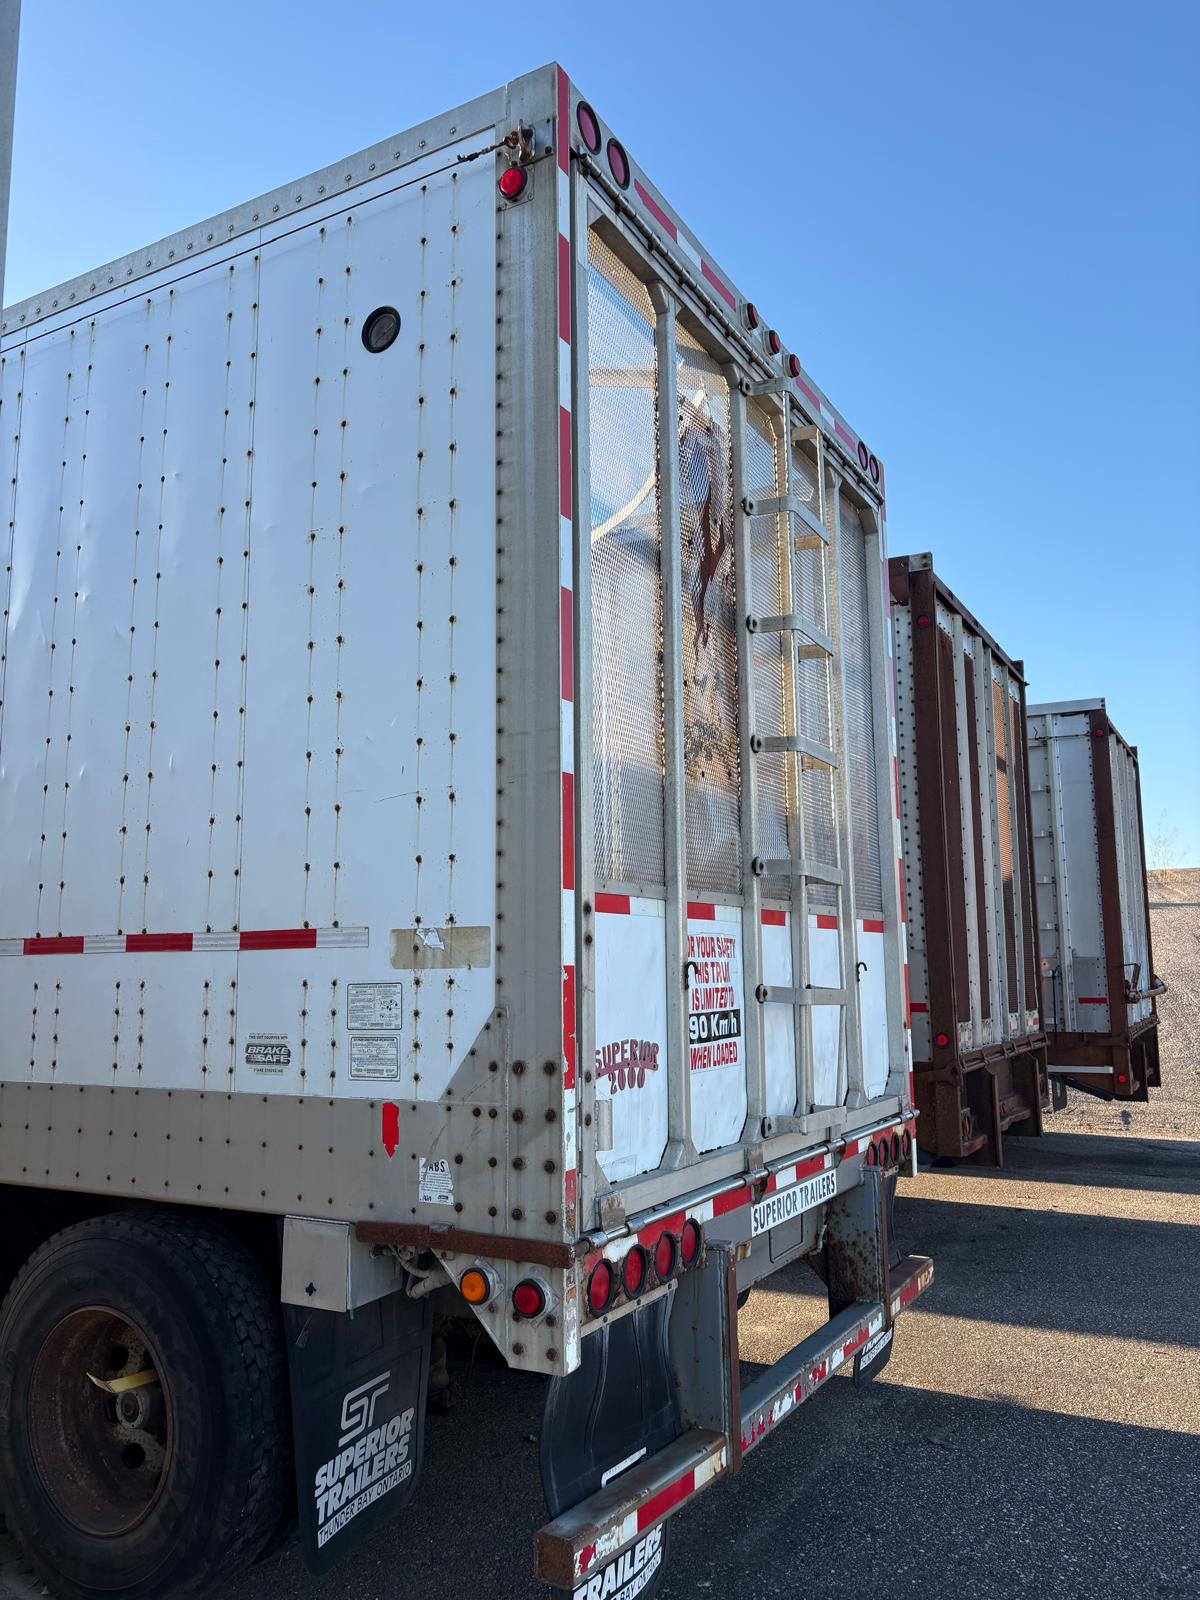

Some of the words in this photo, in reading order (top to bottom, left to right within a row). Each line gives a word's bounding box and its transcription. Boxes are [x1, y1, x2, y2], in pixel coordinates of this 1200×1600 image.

[695, 936, 717, 958] YOUR
[691, 987, 700, 1011] IS
[689, 1015, 708, 1040] 90
[247, 1046, 290, 1054] BRAKE
[258, 1054, 289, 1062] SAFE
[595, 1039, 659, 1072] SUPERIOR
[690, 1045, 712, 1071] WHEN
[712, 1041, 738, 1067] LOADED
[608, 1067, 646, 1095] 2000
[428, 1160, 446, 1173] ABS
[753, 1190, 797, 1233] SUPERIOR
[799, 1172, 836, 1209] TRAILERS
[314, 1407, 415, 1498] SUPERIOR
[316, 1433, 410, 1526] TRAILERS
[319, 1504, 355, 1544] THUNDER
[356, 1489, 374, 1513] BAY
[377, 1463, 411, 1497] ONTARIO
